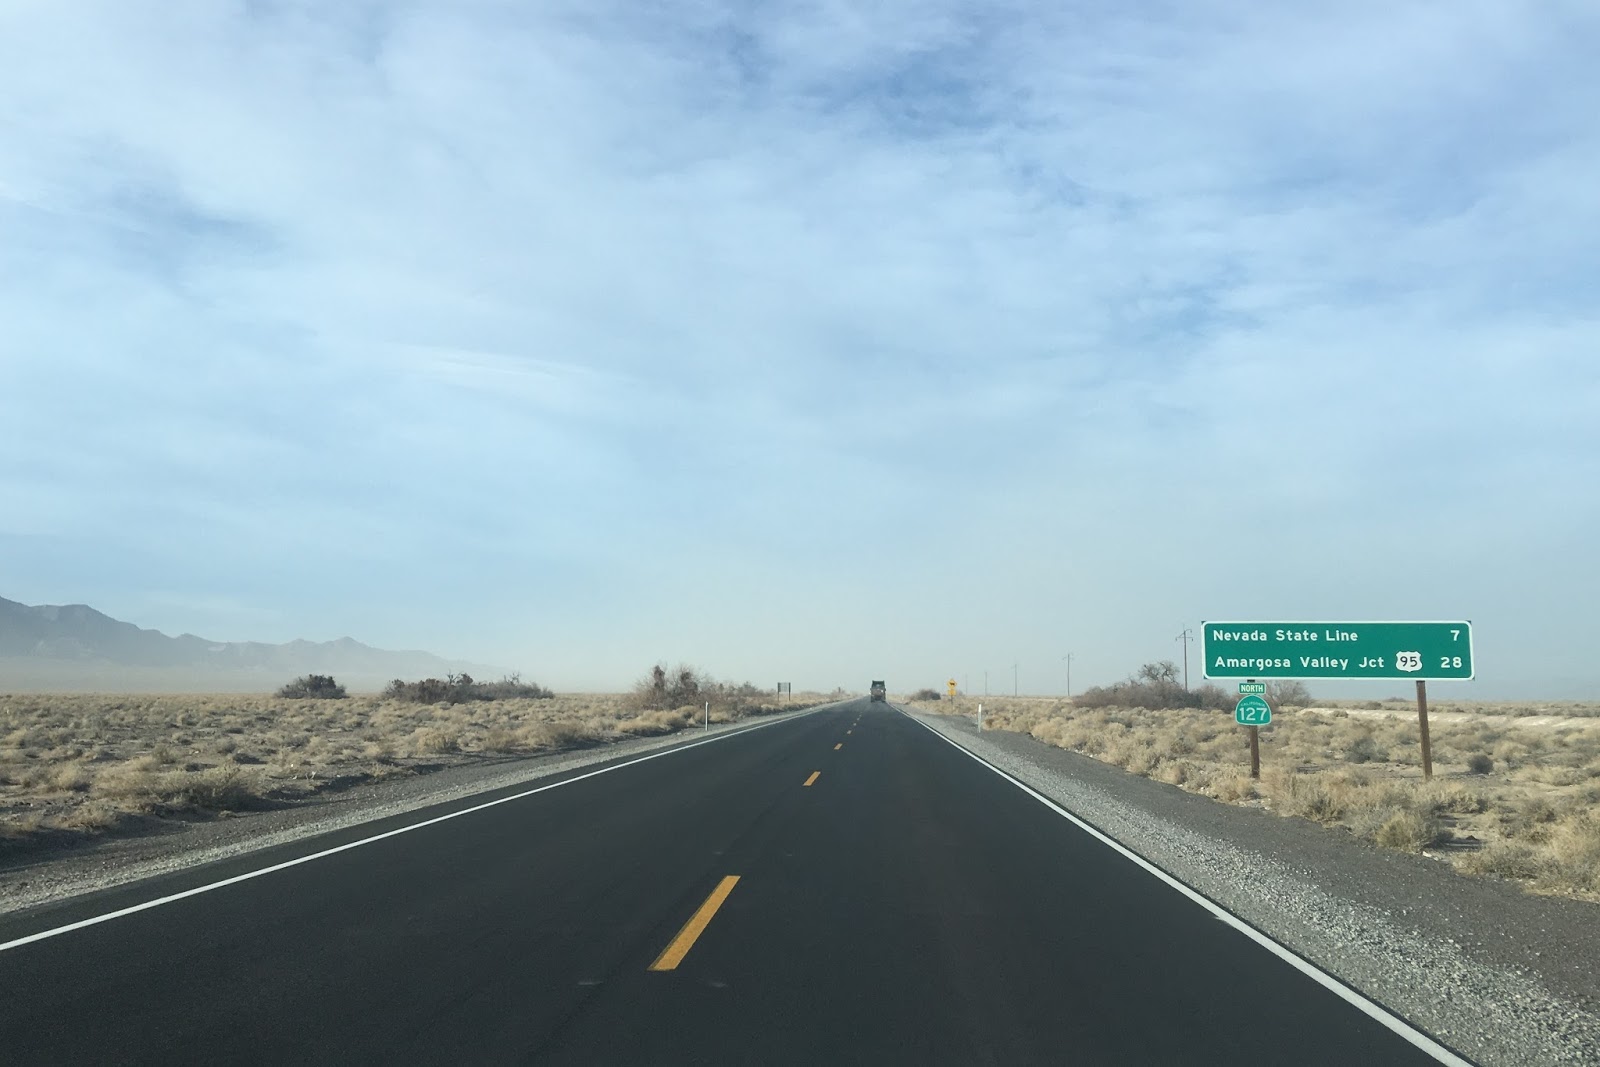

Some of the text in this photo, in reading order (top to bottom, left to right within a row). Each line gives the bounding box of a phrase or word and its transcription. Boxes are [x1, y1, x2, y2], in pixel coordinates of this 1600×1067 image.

[1213, 629, 1460, 641] Nevada State Line 7
[1214, 655, 1463, 671] Amargosa Valley Jct 95 28
[1240, 684, 1264, 693] NORTH
[1239, 707, 1268, 721] 127
